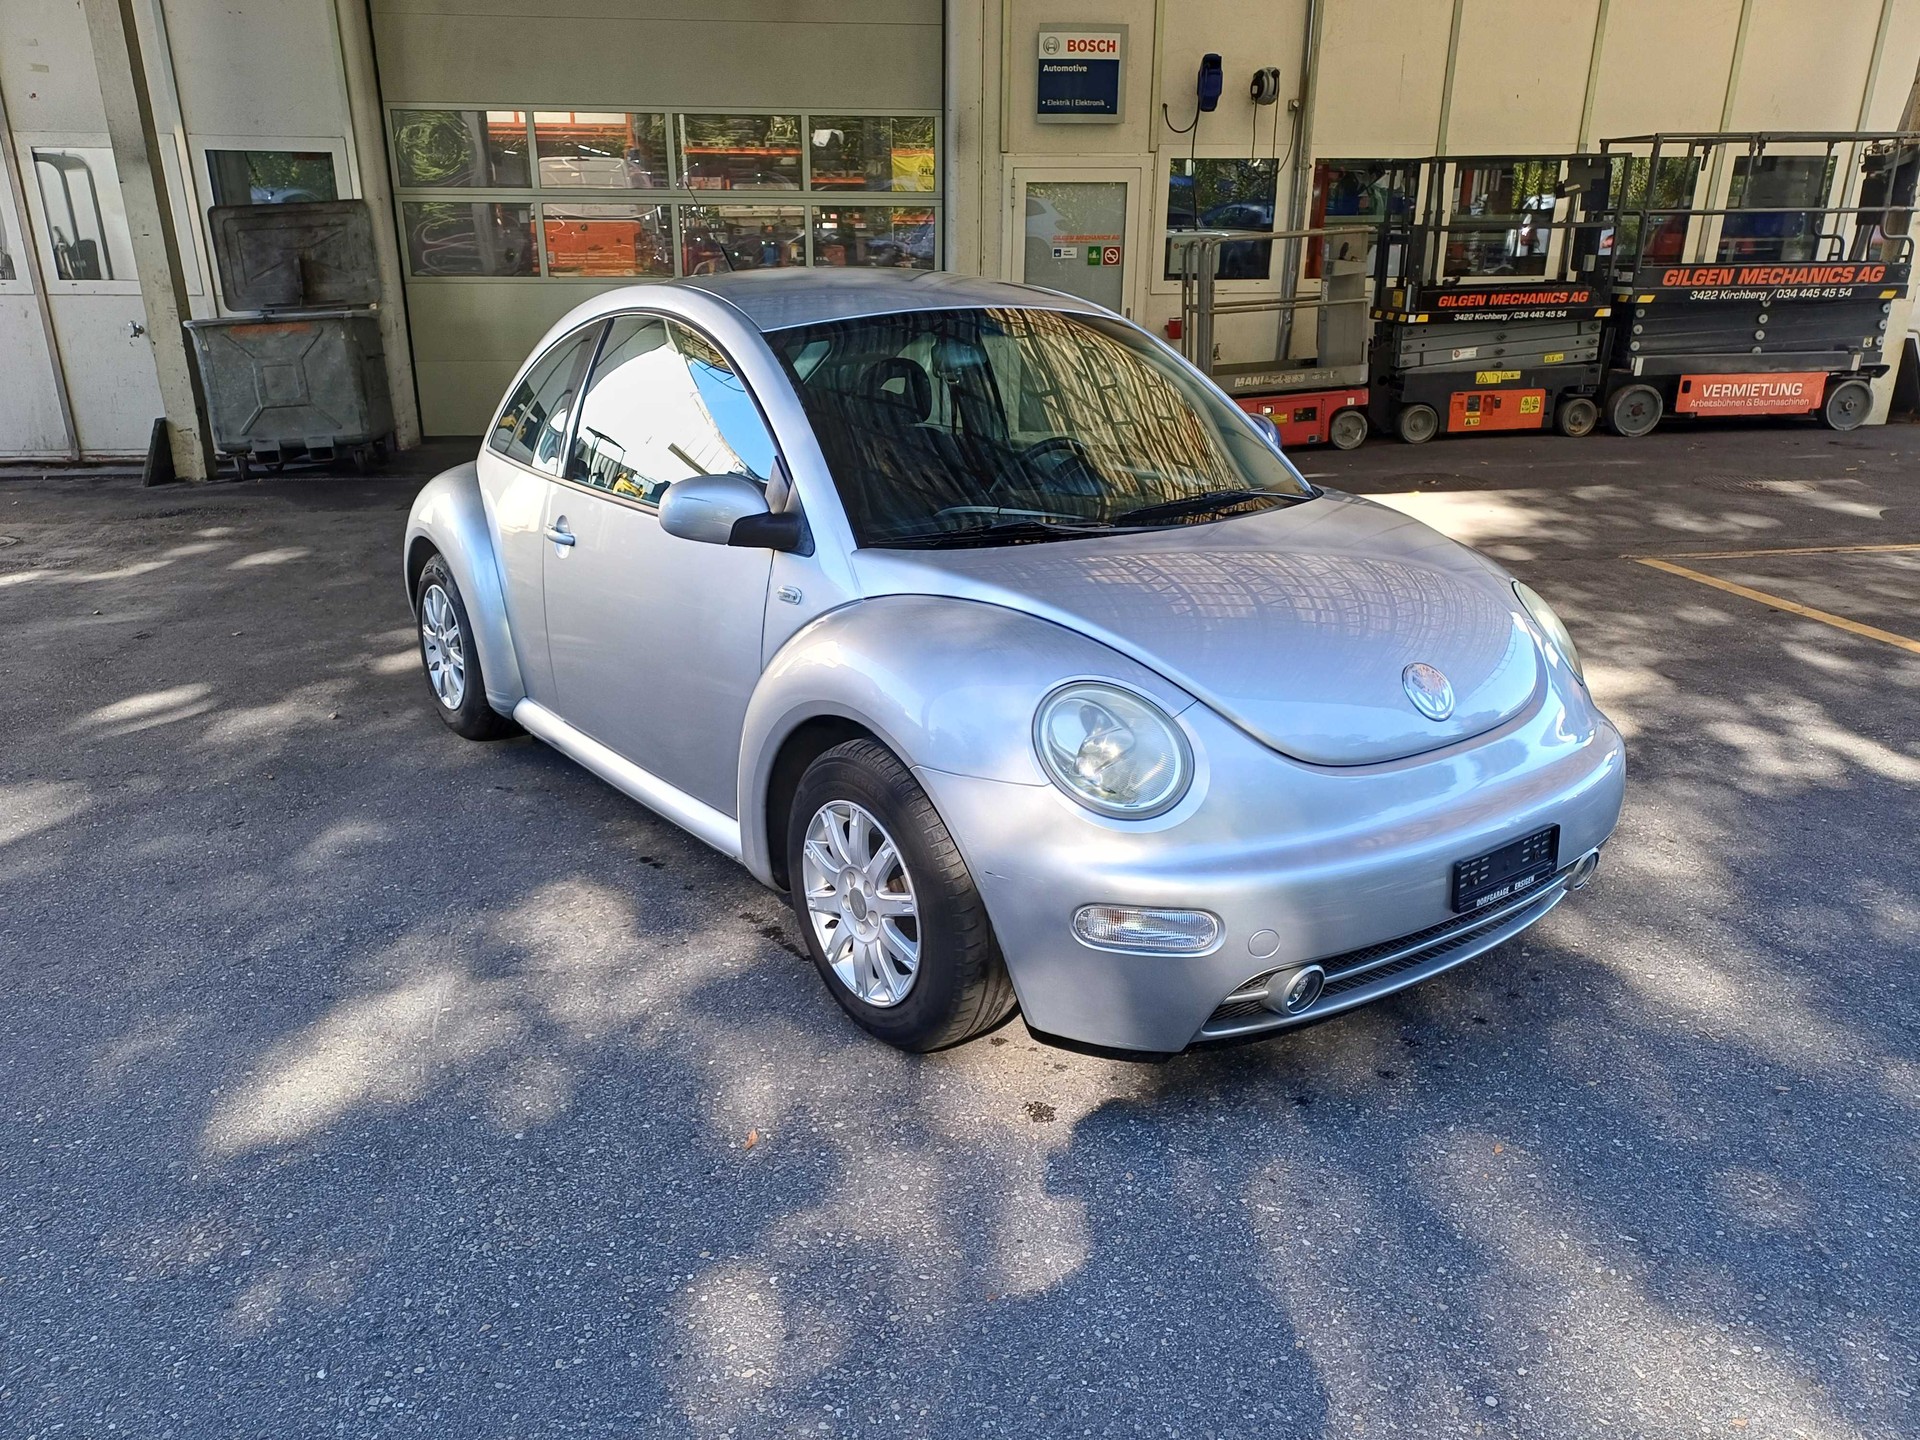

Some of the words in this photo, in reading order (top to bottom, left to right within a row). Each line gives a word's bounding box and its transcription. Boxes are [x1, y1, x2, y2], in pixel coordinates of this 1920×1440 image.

[1067, 39, 1116, 53] BOSCH
[1043, 64, 1088, 73] Automotive
[1047, 99, 1070, 107] Elektrik
[1075, 99, 1105, 107] Elektronik
[1662, 268, 1734, 286] GILGEN
[1737, 267, 1854, 285] MECHANICS
[1855, 266, 1885, 283] AG
[1438, 296, 1486, 307] GILGEN
[1489, 292, 1568, 306] MECHANICS
[1570, 291, 1588, 303] AG
[1690, 290, 1717, 300] 3422
[1719, 289, 1766, 301] Kirchberg
[1776, 289, 1797, 299] 034
[1799, 289, 1820, 298] 445
[1821, 288, 1836, 298] 45
[1838, 287, 1852, 297] 54
[1454, 313, 1473, 322] 3422
[1475, 312, 1507, 322] Kirchberg
[1557, 310, 1567, 318] 54
[1703, 383, 1803, 397] VERMIETUNG
[1689, 400, 1745, 408] Arbeitsbühnen
[1746, 399, 1752, 407] &
[1753, 398, 1809, 407] Baumaschinen
